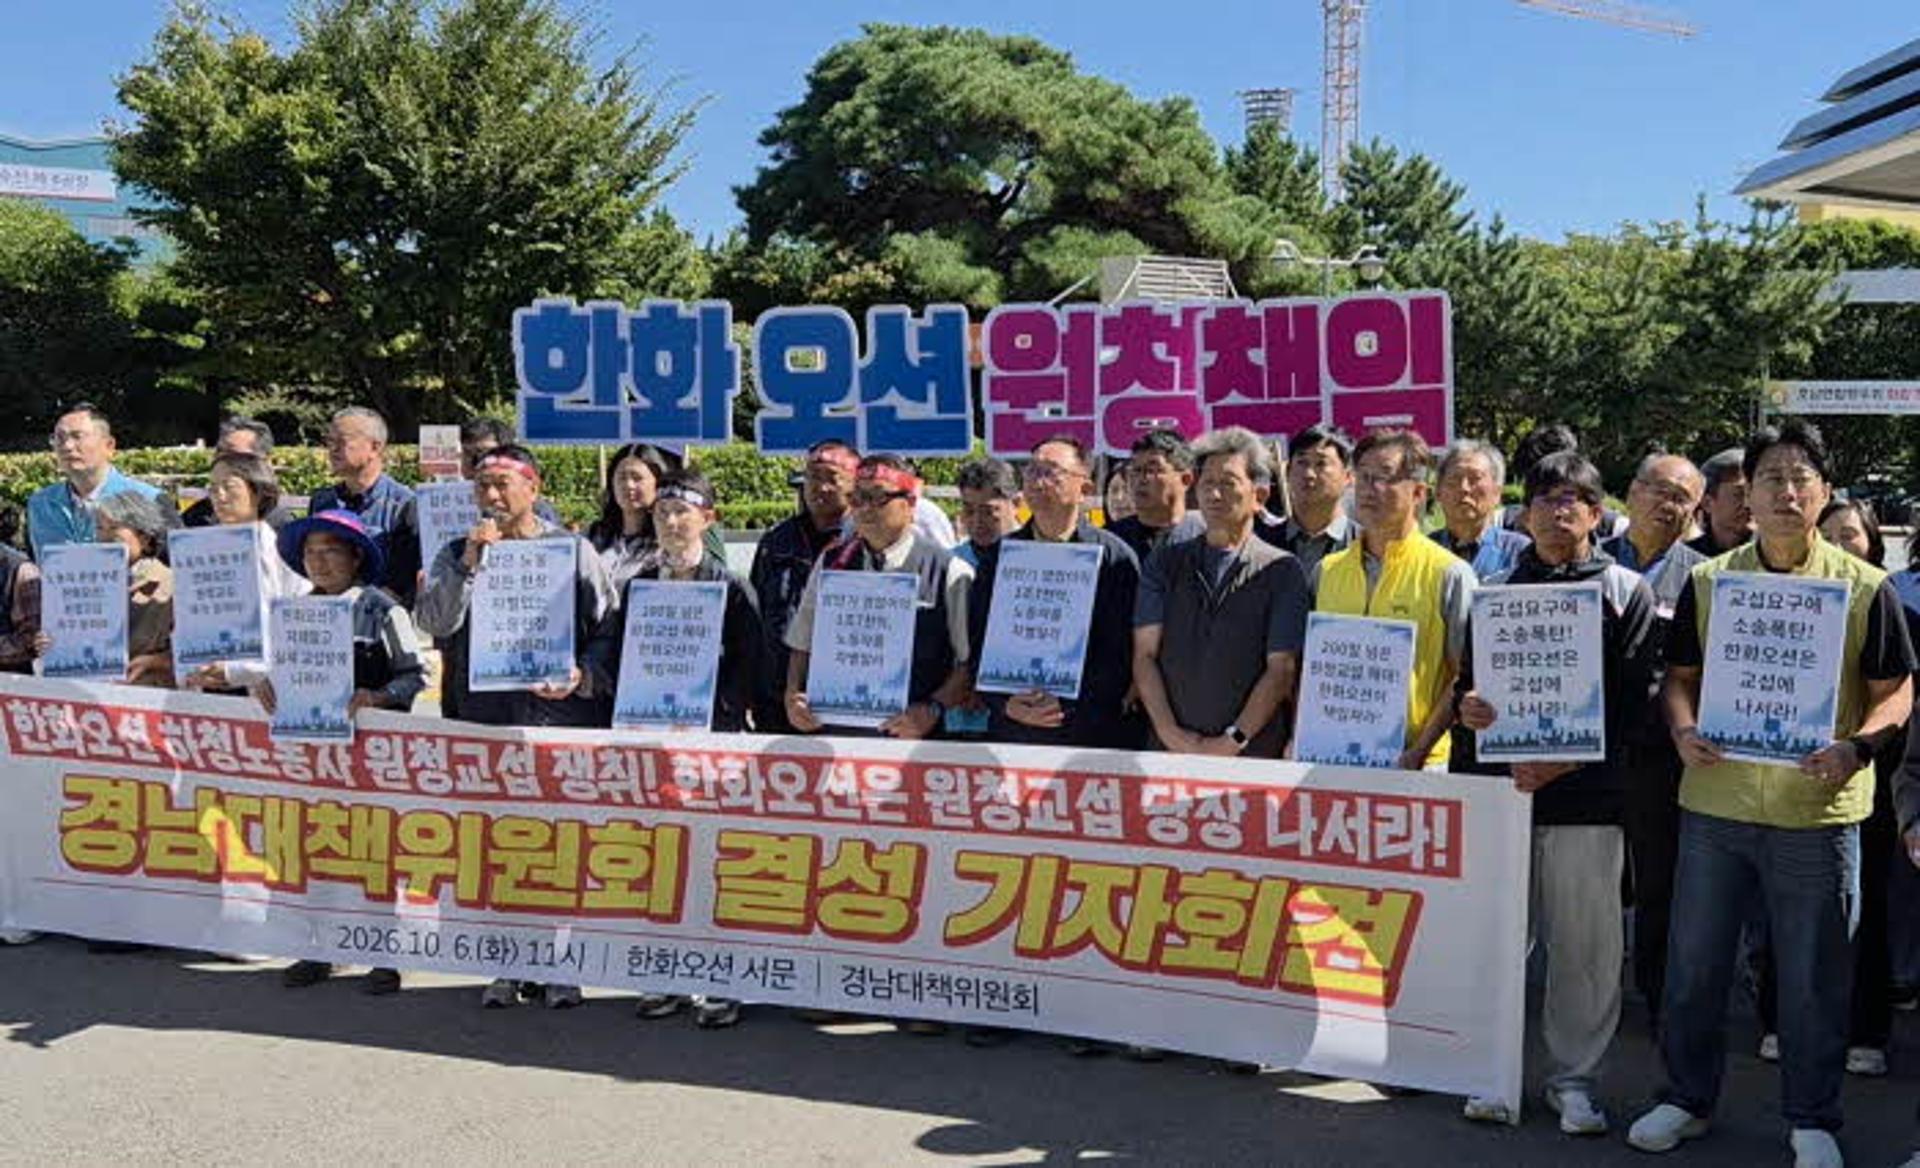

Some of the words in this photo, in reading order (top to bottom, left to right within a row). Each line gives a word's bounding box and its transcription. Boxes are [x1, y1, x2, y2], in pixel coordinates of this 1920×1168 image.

[517, 301, 740, 441] 한화
[757, 307, 970, 452] 오션
[986, 296, 1449, 455] 원청책임
[1488, 599, 1578, 620] 교섭요구에
[1729, 587, 1824, 615] 교섭요구에
[1495, 624, 1574, 646] 소송폭탄!
[1733, 617, 1816, 642] 소송폭탄!
[1490, 649, 1579, 671] 한화오션은
[1723, 641, 1818, 671] 한화오션은
[1509, 675, 1562, 695] 교섭에
[1739, 670, 1796, 695] 교섭에
[1507, 700, 1568, 720] 나서라!
[1734, 698, 1798, 723] 나서라!
[8, 698, 160, 765] 한화오션
[364, 734, 542, 799] 원청교섭
[551, 745, 660, 806] 쟁취!
[669, 749, 911, 823] 한화오션은
[923, 767, 1126, 838] 원청교섭
[1139, 779, 1248, 851] 당장
[1265, 794, 1450, 871] 나서라!
[62, 774, 687, 920] 경남대책위원회
[713, 829, 928, 939] 결성
[944, 848, 1423, 1008] 기자회견
[526, 940, 586, 973] 11시
[627, 945, 734, 986] 한화오션
[740, 957, 798, 991] 서문
[840, 962, 1040, 1017] 경남대책위원회
